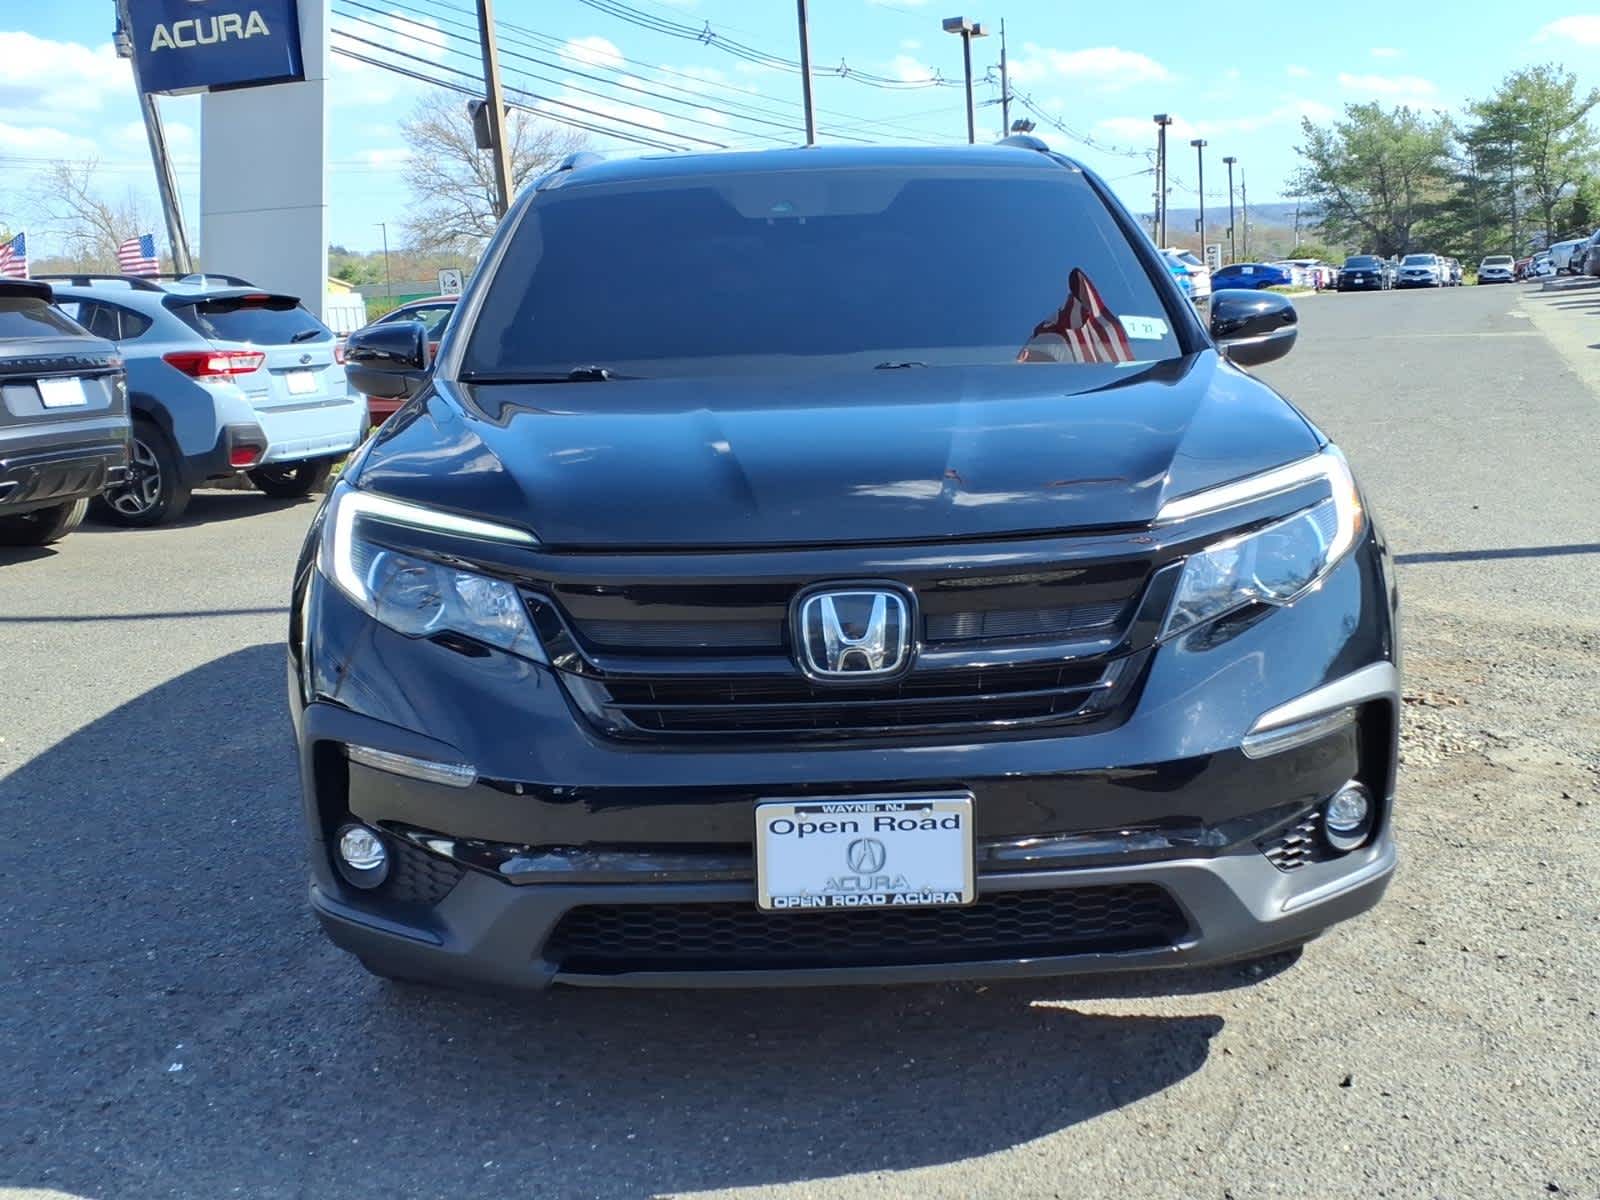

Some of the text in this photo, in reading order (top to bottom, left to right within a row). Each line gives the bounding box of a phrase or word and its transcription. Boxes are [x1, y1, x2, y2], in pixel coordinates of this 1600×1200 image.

[150, 10, 271, 52] ACURA
[885, 803, 906, 812] NJ
[769, 814, 961, 838] Open Road
[823, 875, 910, 892] ACURA
[773, 891, 960, 908] OPEN ROAD ACURA
